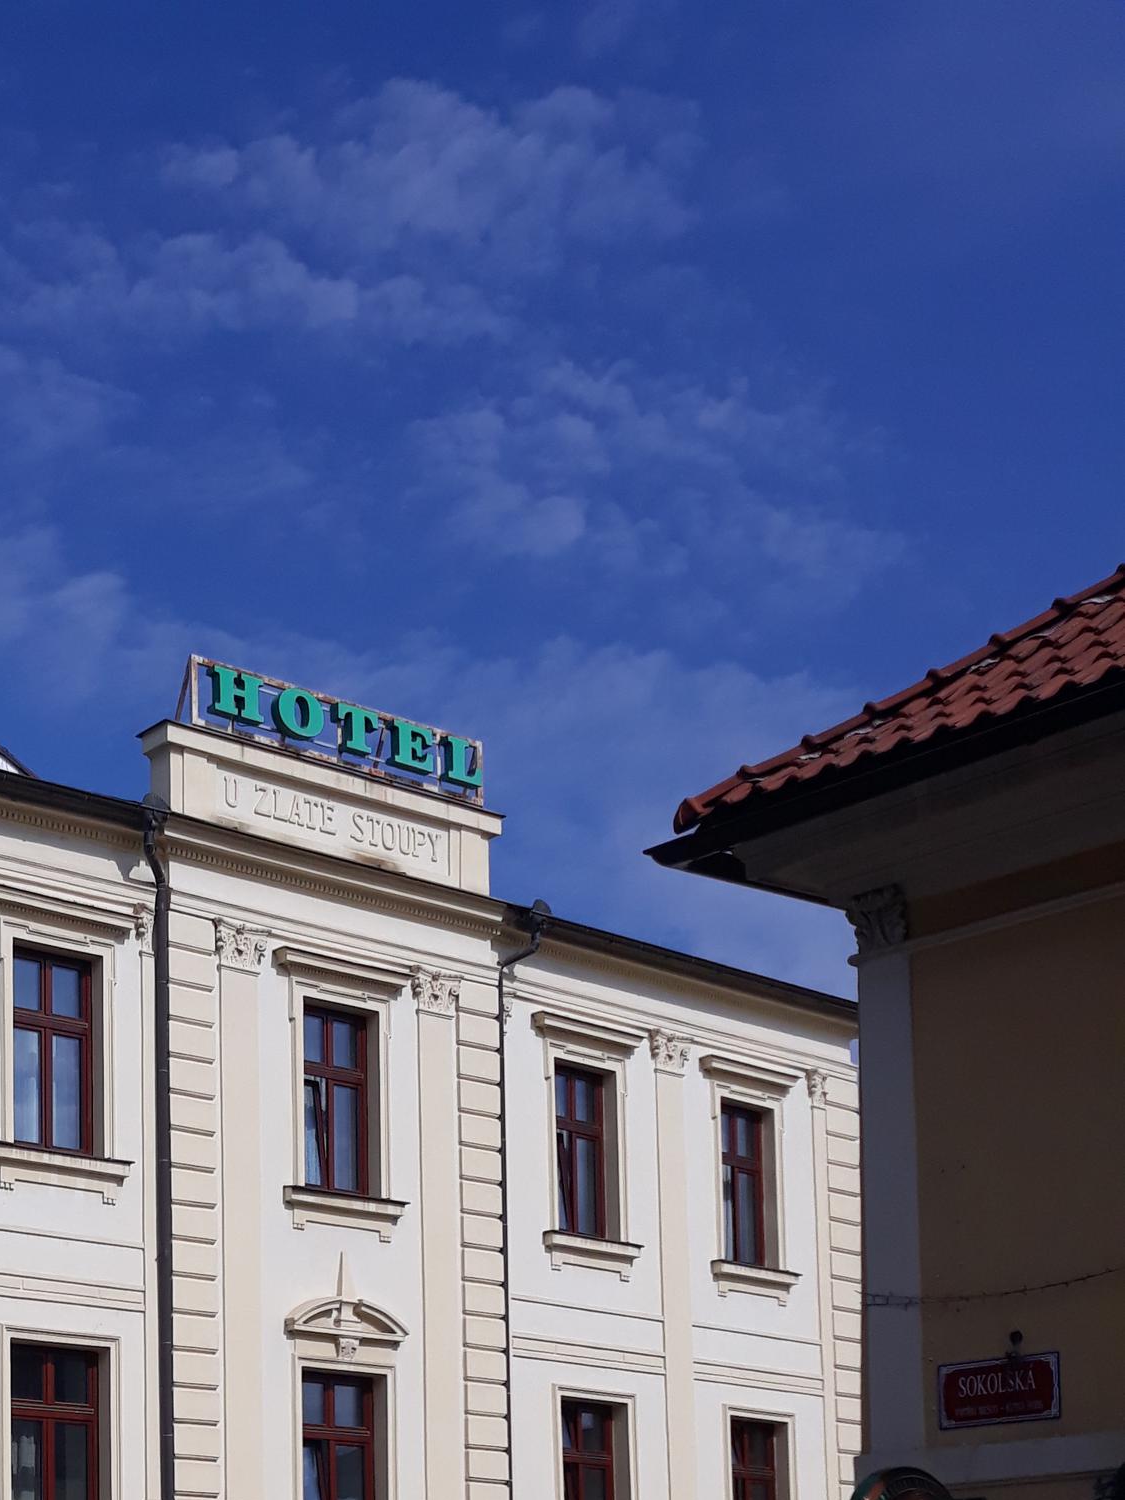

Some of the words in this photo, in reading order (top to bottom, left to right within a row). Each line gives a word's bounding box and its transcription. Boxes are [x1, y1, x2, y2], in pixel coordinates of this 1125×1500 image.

[206, 665, 482, 788] HOTEL
[223, 775, 239, 809] U
[350, 812, 442, 862] STOUPY
[958, 1364, 1036, 1398] SOKOLSKÁ
